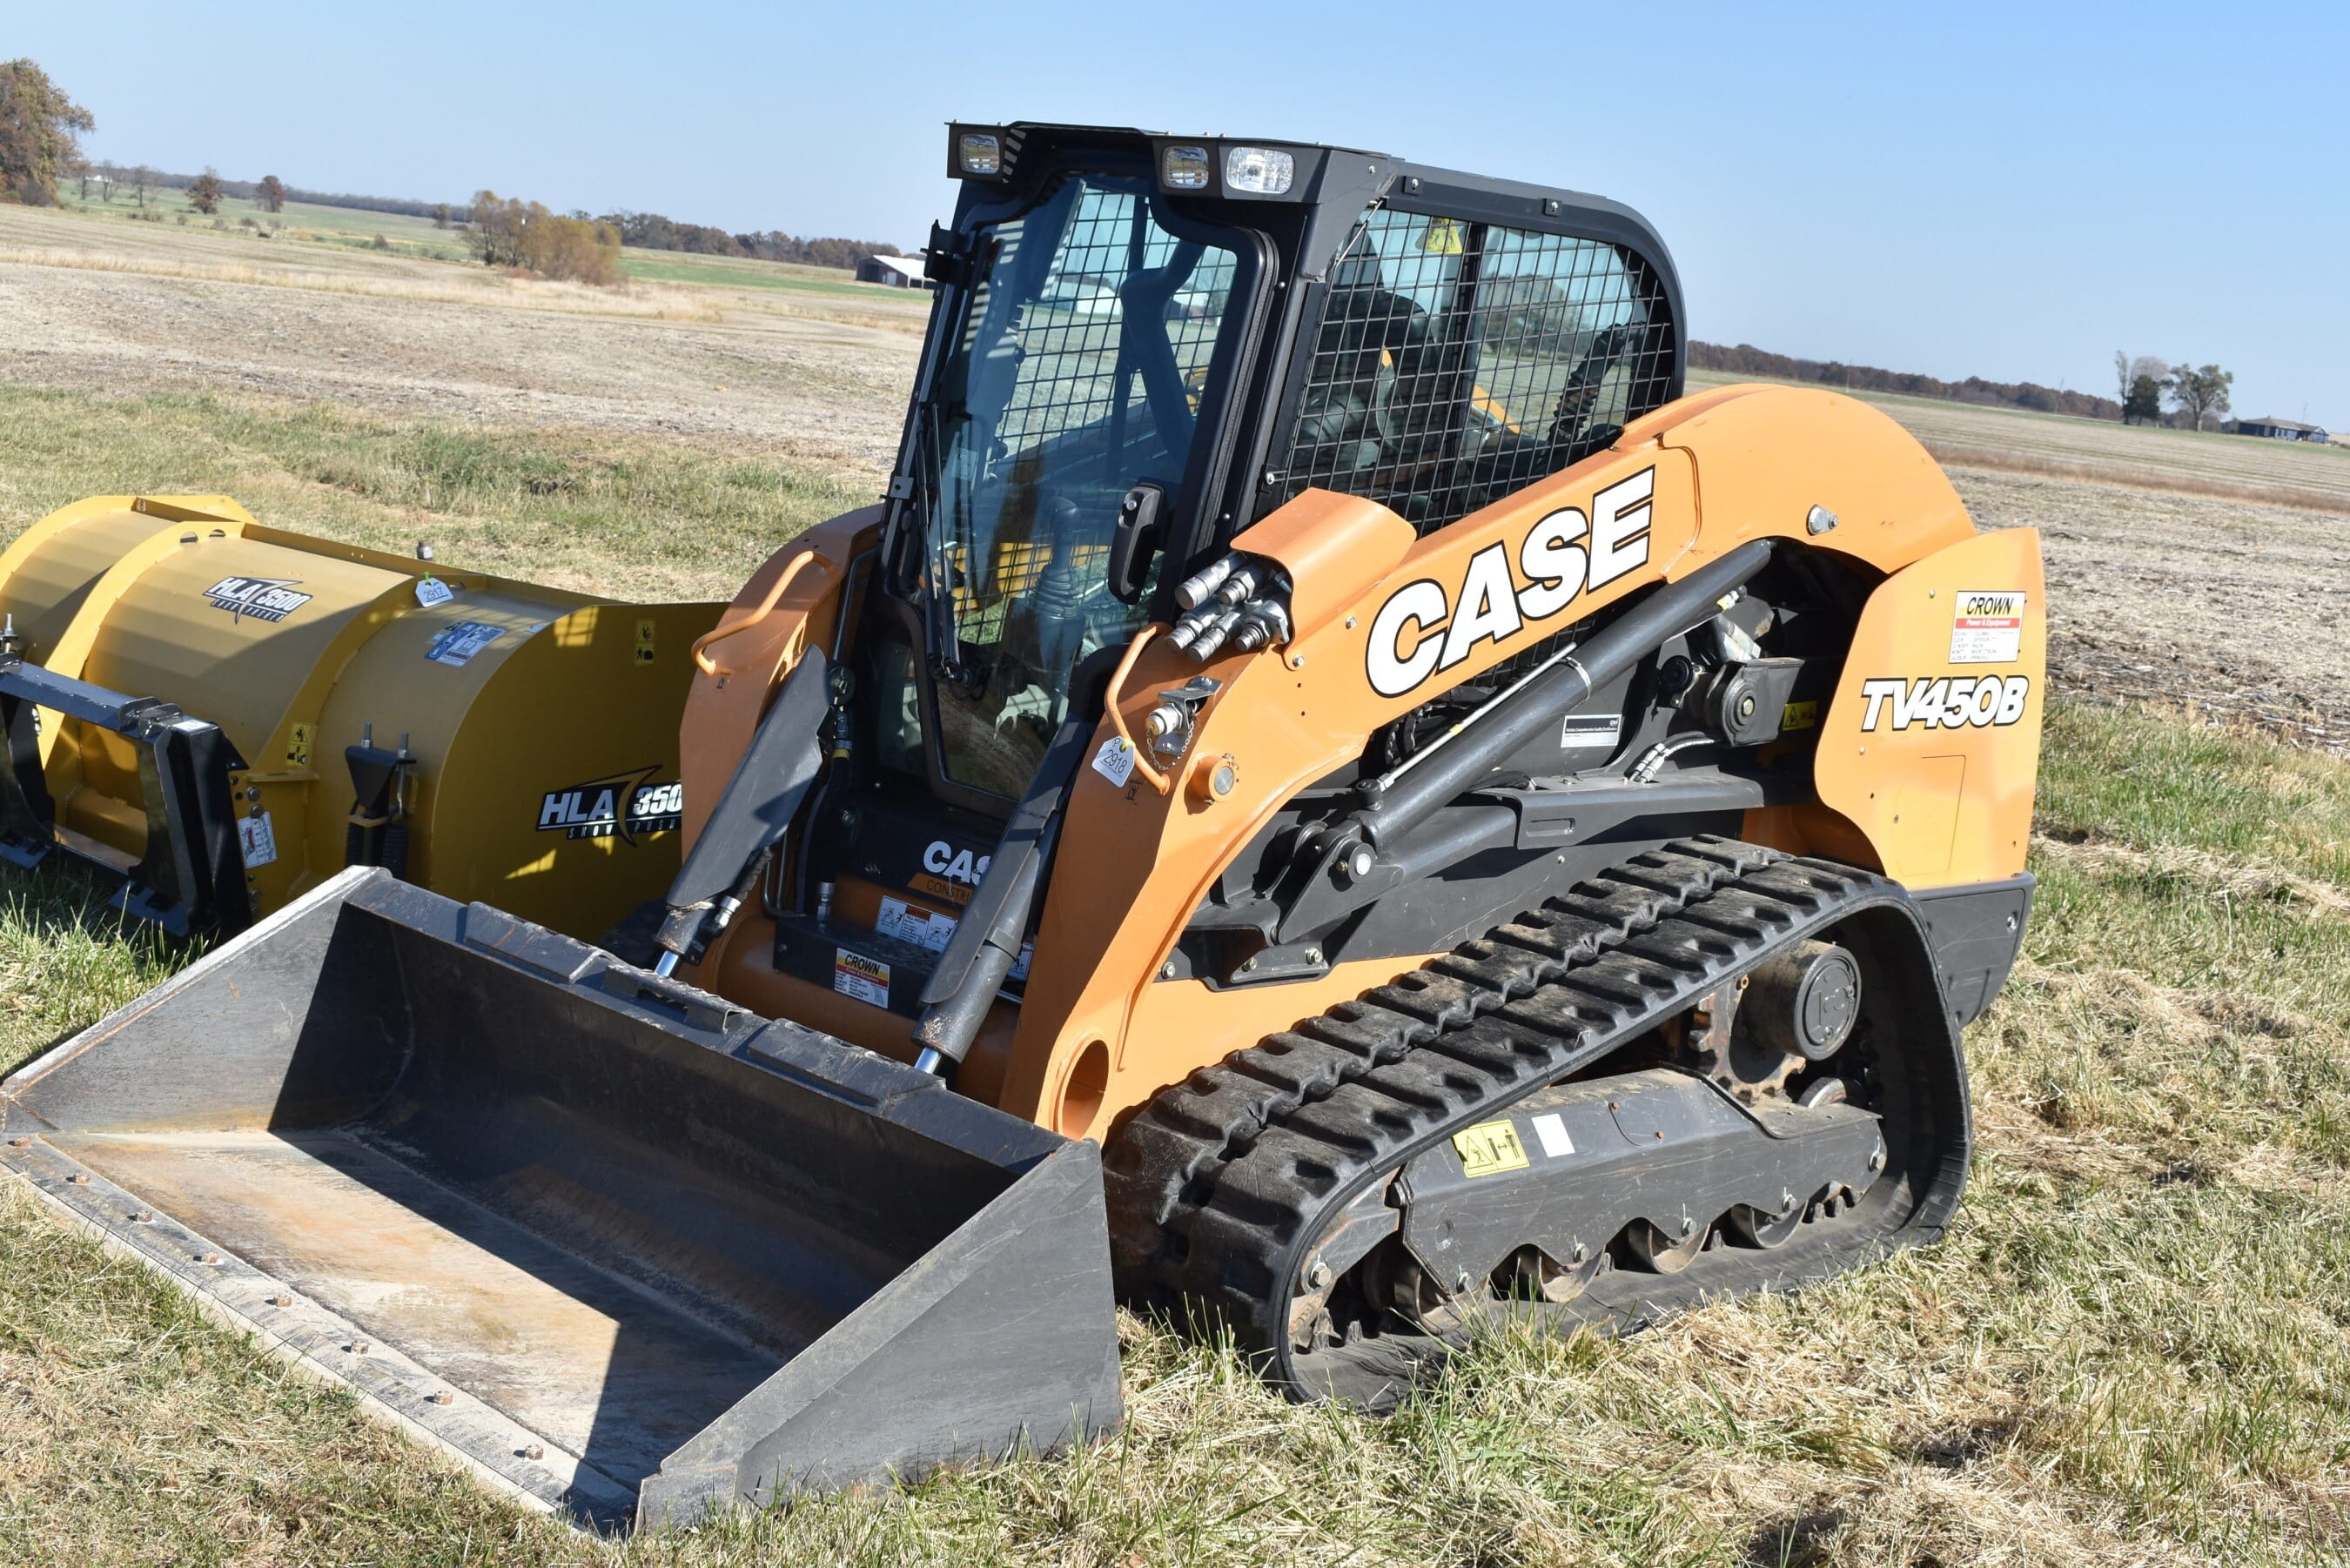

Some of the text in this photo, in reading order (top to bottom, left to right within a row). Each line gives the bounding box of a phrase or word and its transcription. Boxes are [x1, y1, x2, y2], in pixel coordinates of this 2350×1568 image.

[209, 577, 312, 611] HLA 3500
[423, 586, 444, 600] 2917
[1365, 464, 1656, 699] CASE
[1966, 596, 2015, 616] CROWN
[1860, 673, 2031, 734] TV450B
[1103, 749, 1128, 774] 2918
[540, 783, 682, 825] HLA 350
[568, 819, 676, 839] SNOW PUSH
[923, 841, 991, 886] CAS
[926, 879, 970, 903] CONSTR
[845, 954, 881, 975] CROWN
